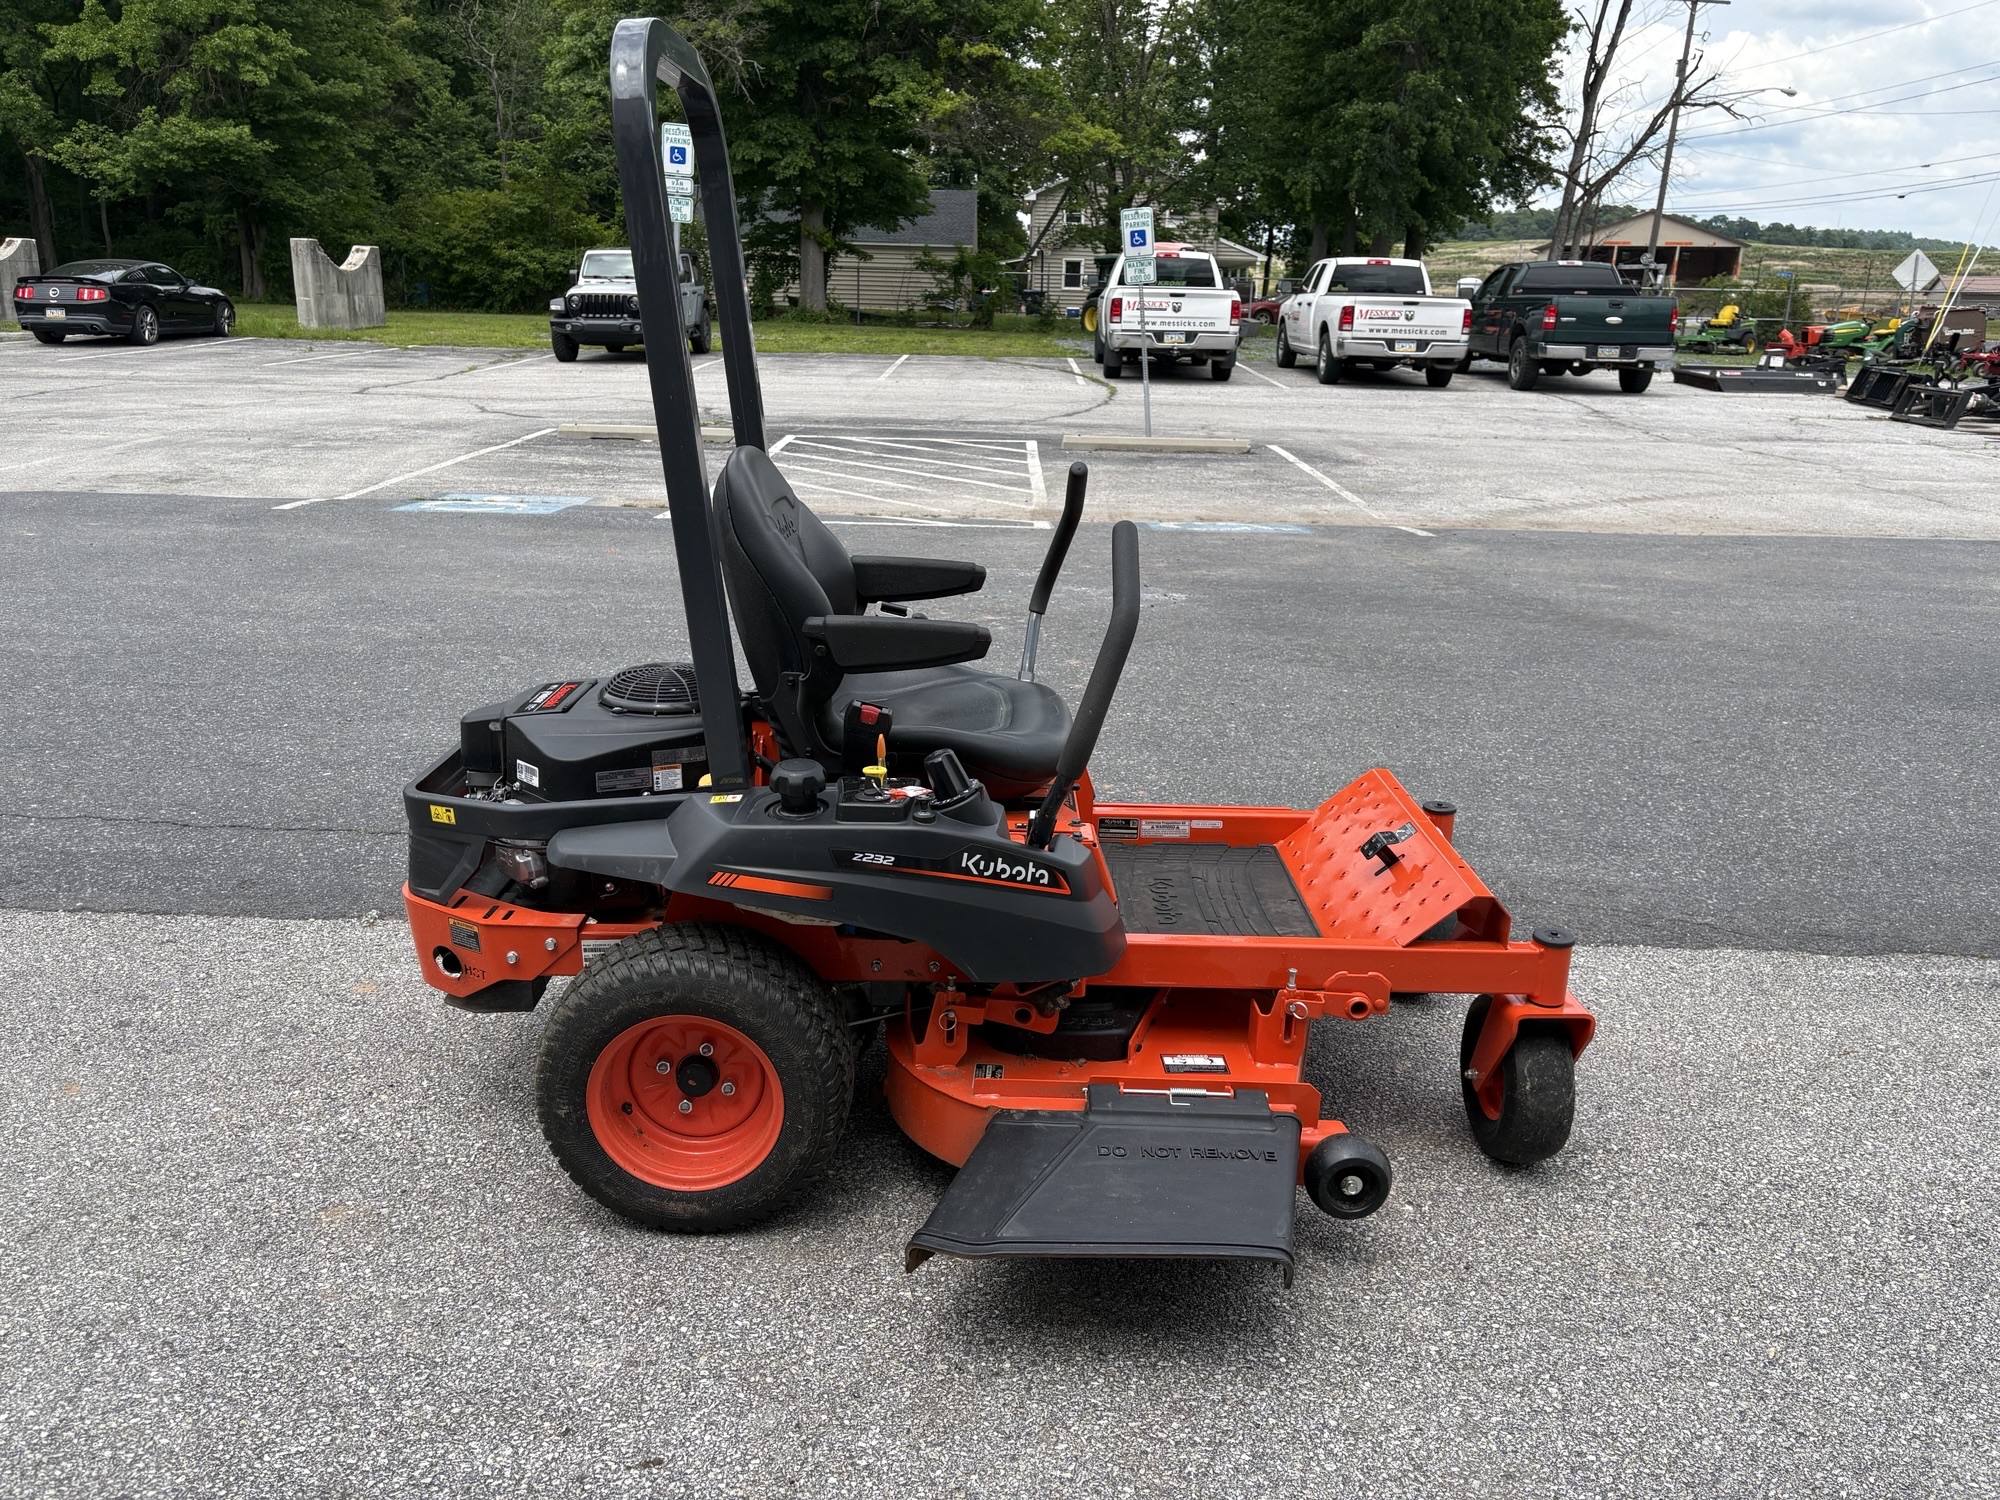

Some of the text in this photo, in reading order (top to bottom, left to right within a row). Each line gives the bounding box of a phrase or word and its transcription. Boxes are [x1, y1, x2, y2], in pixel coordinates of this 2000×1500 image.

[666, 137, 690, 145] PARKING
[1368, 327, 1448, 336] www.messicks.com
[961, 852, 1049, 884] Kubota
[1149, 878, 1182, 924] Kubota
[1097, 1145, 1278, 1162] DO NOT REMOVE
